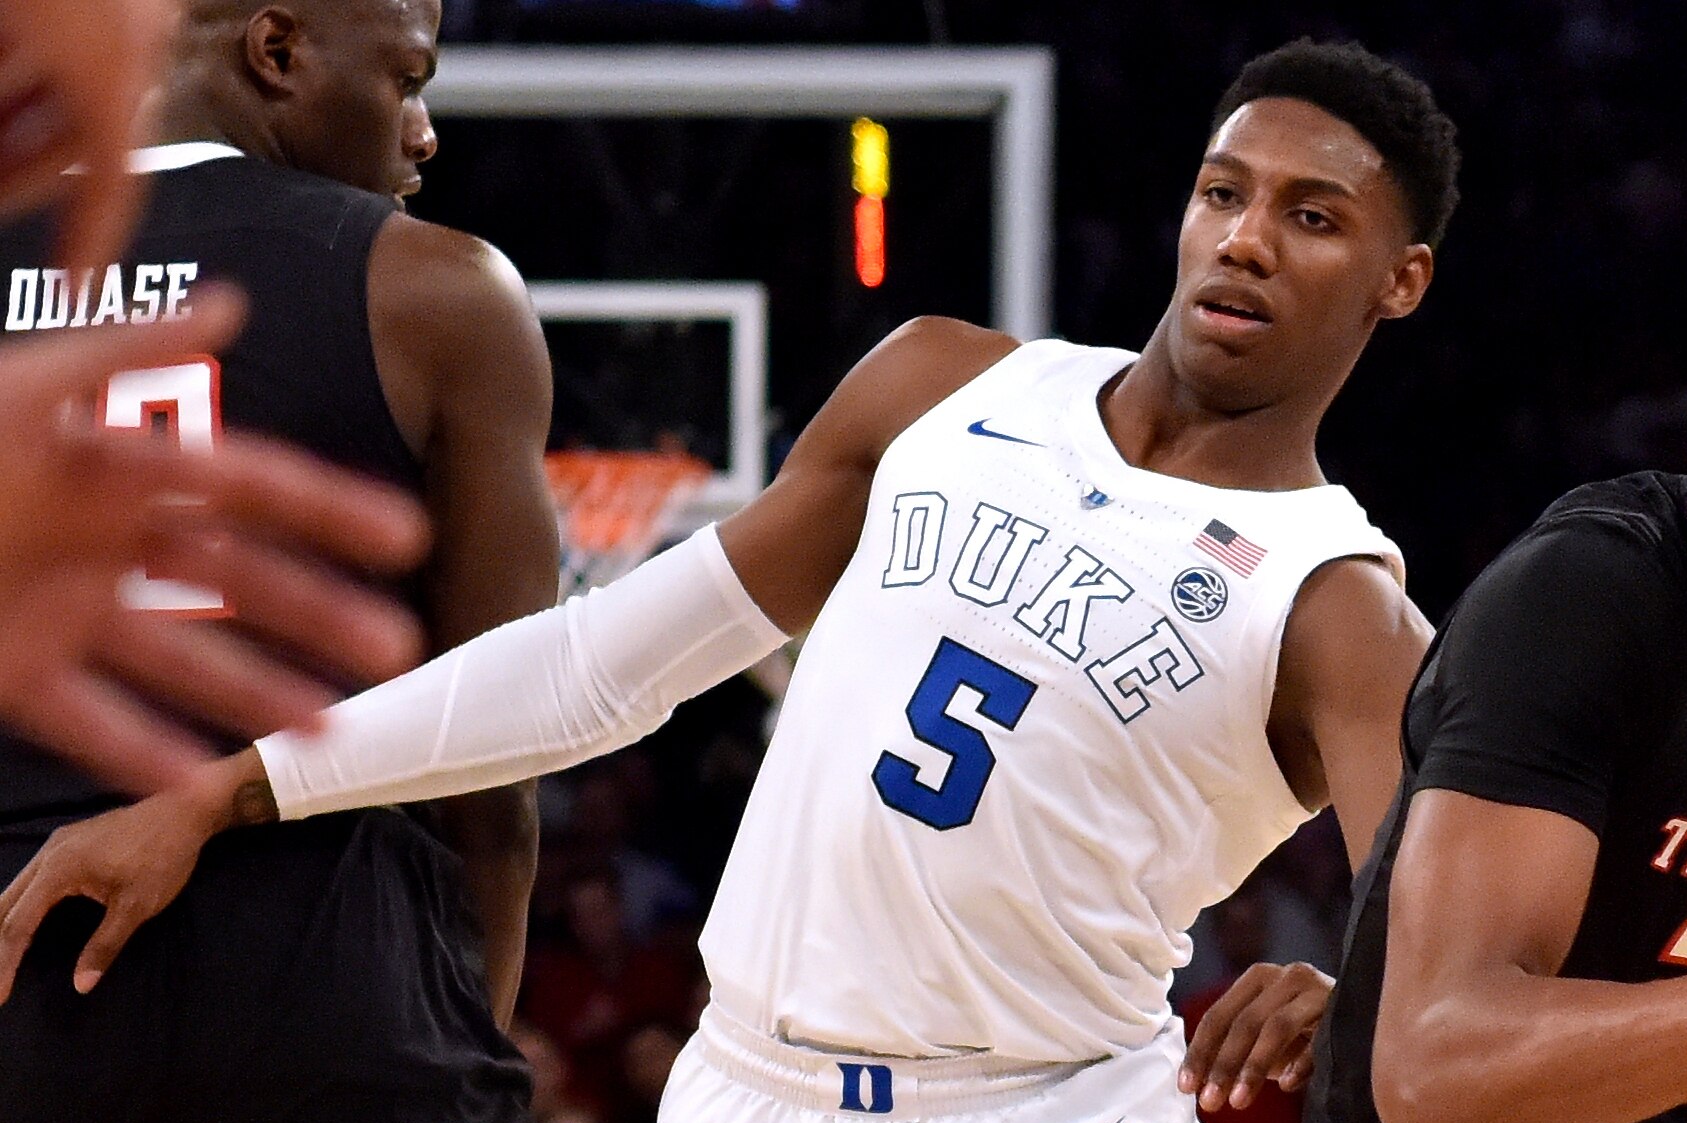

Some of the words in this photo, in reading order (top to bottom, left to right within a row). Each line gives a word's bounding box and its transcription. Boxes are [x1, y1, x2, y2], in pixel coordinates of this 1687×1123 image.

[5, 262, 198, 331] ODIASE
[882, 491, 1204, 725] DUKE
[871, 635, 1038, 831] 5
[836, 1062, 893, 1114] D
